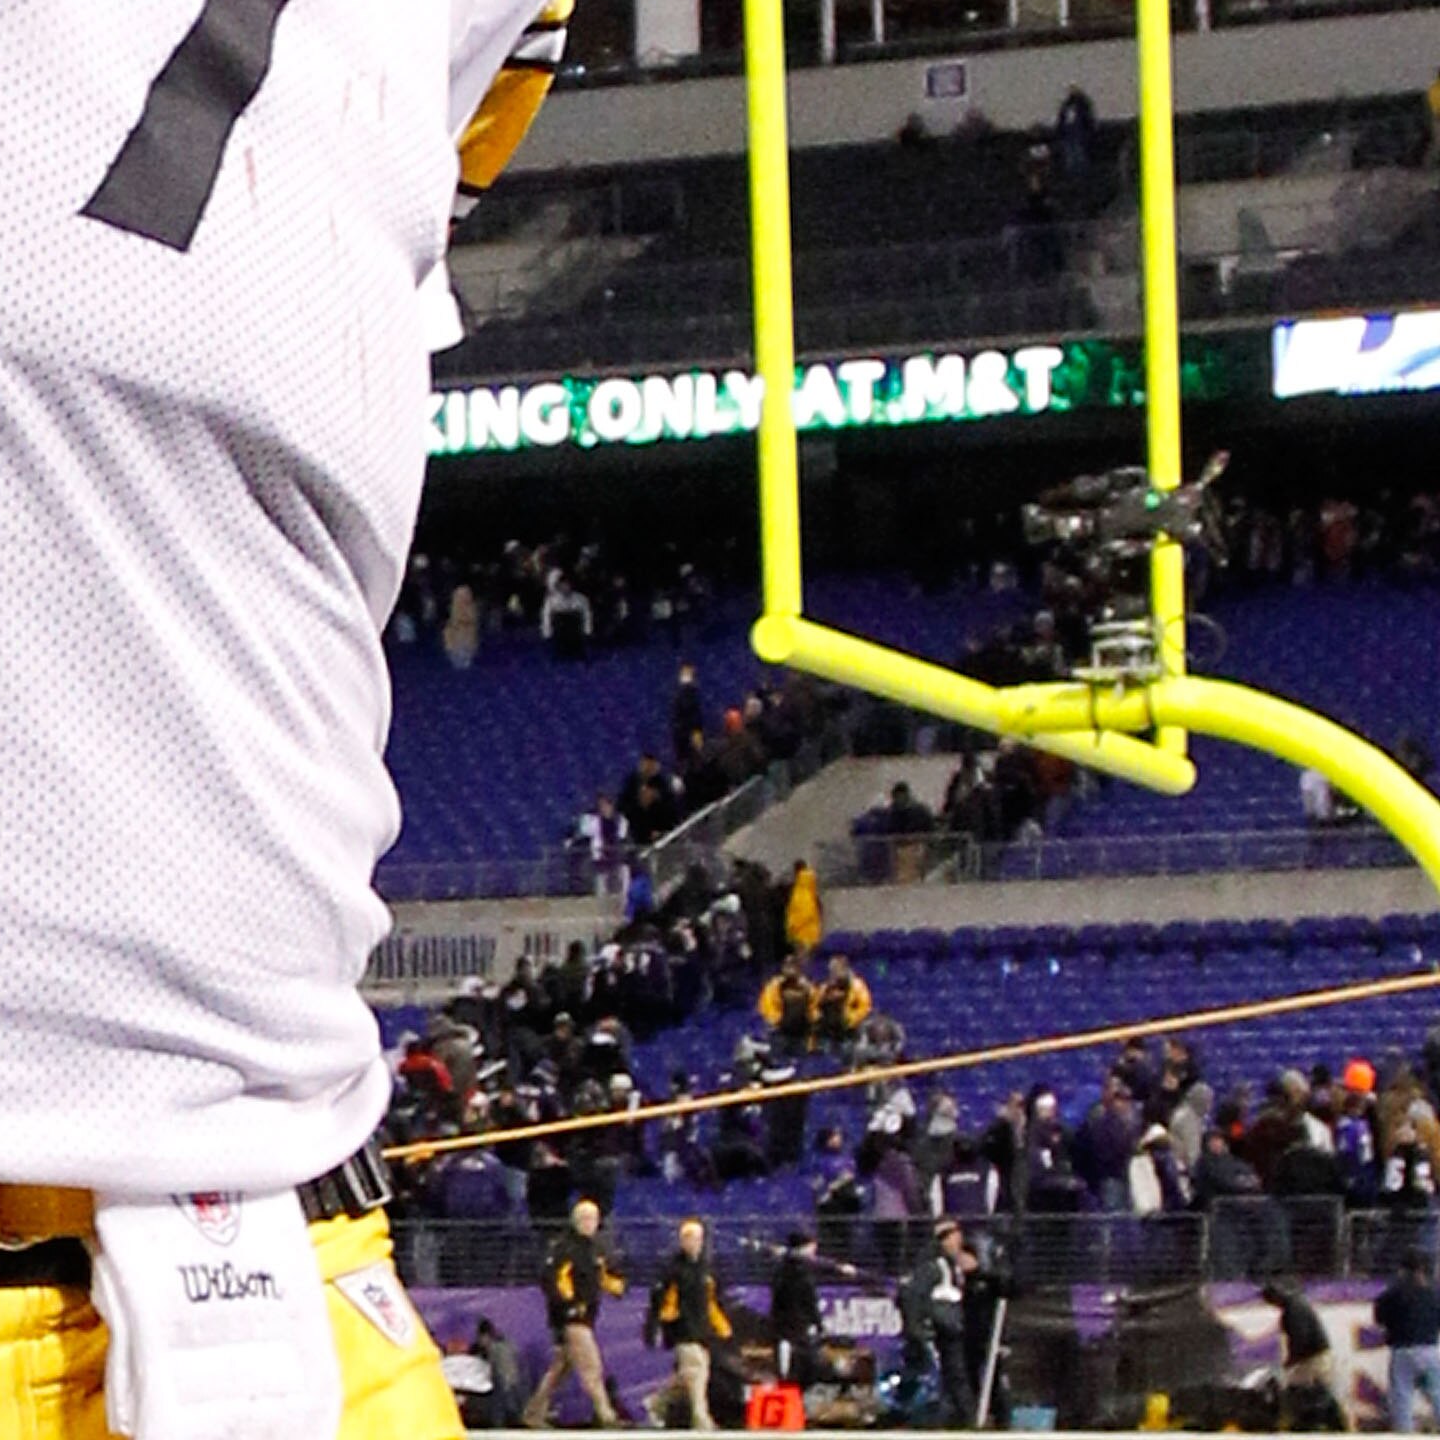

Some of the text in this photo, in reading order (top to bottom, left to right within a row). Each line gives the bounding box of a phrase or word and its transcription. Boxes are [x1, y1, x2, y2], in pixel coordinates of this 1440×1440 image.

[589, 370, 765, 441] ONLY
[795, 360, 885, 427] AT
[903, 346, 1063, 423] M&T
[177, 1261, 283, 1303] Wilson
